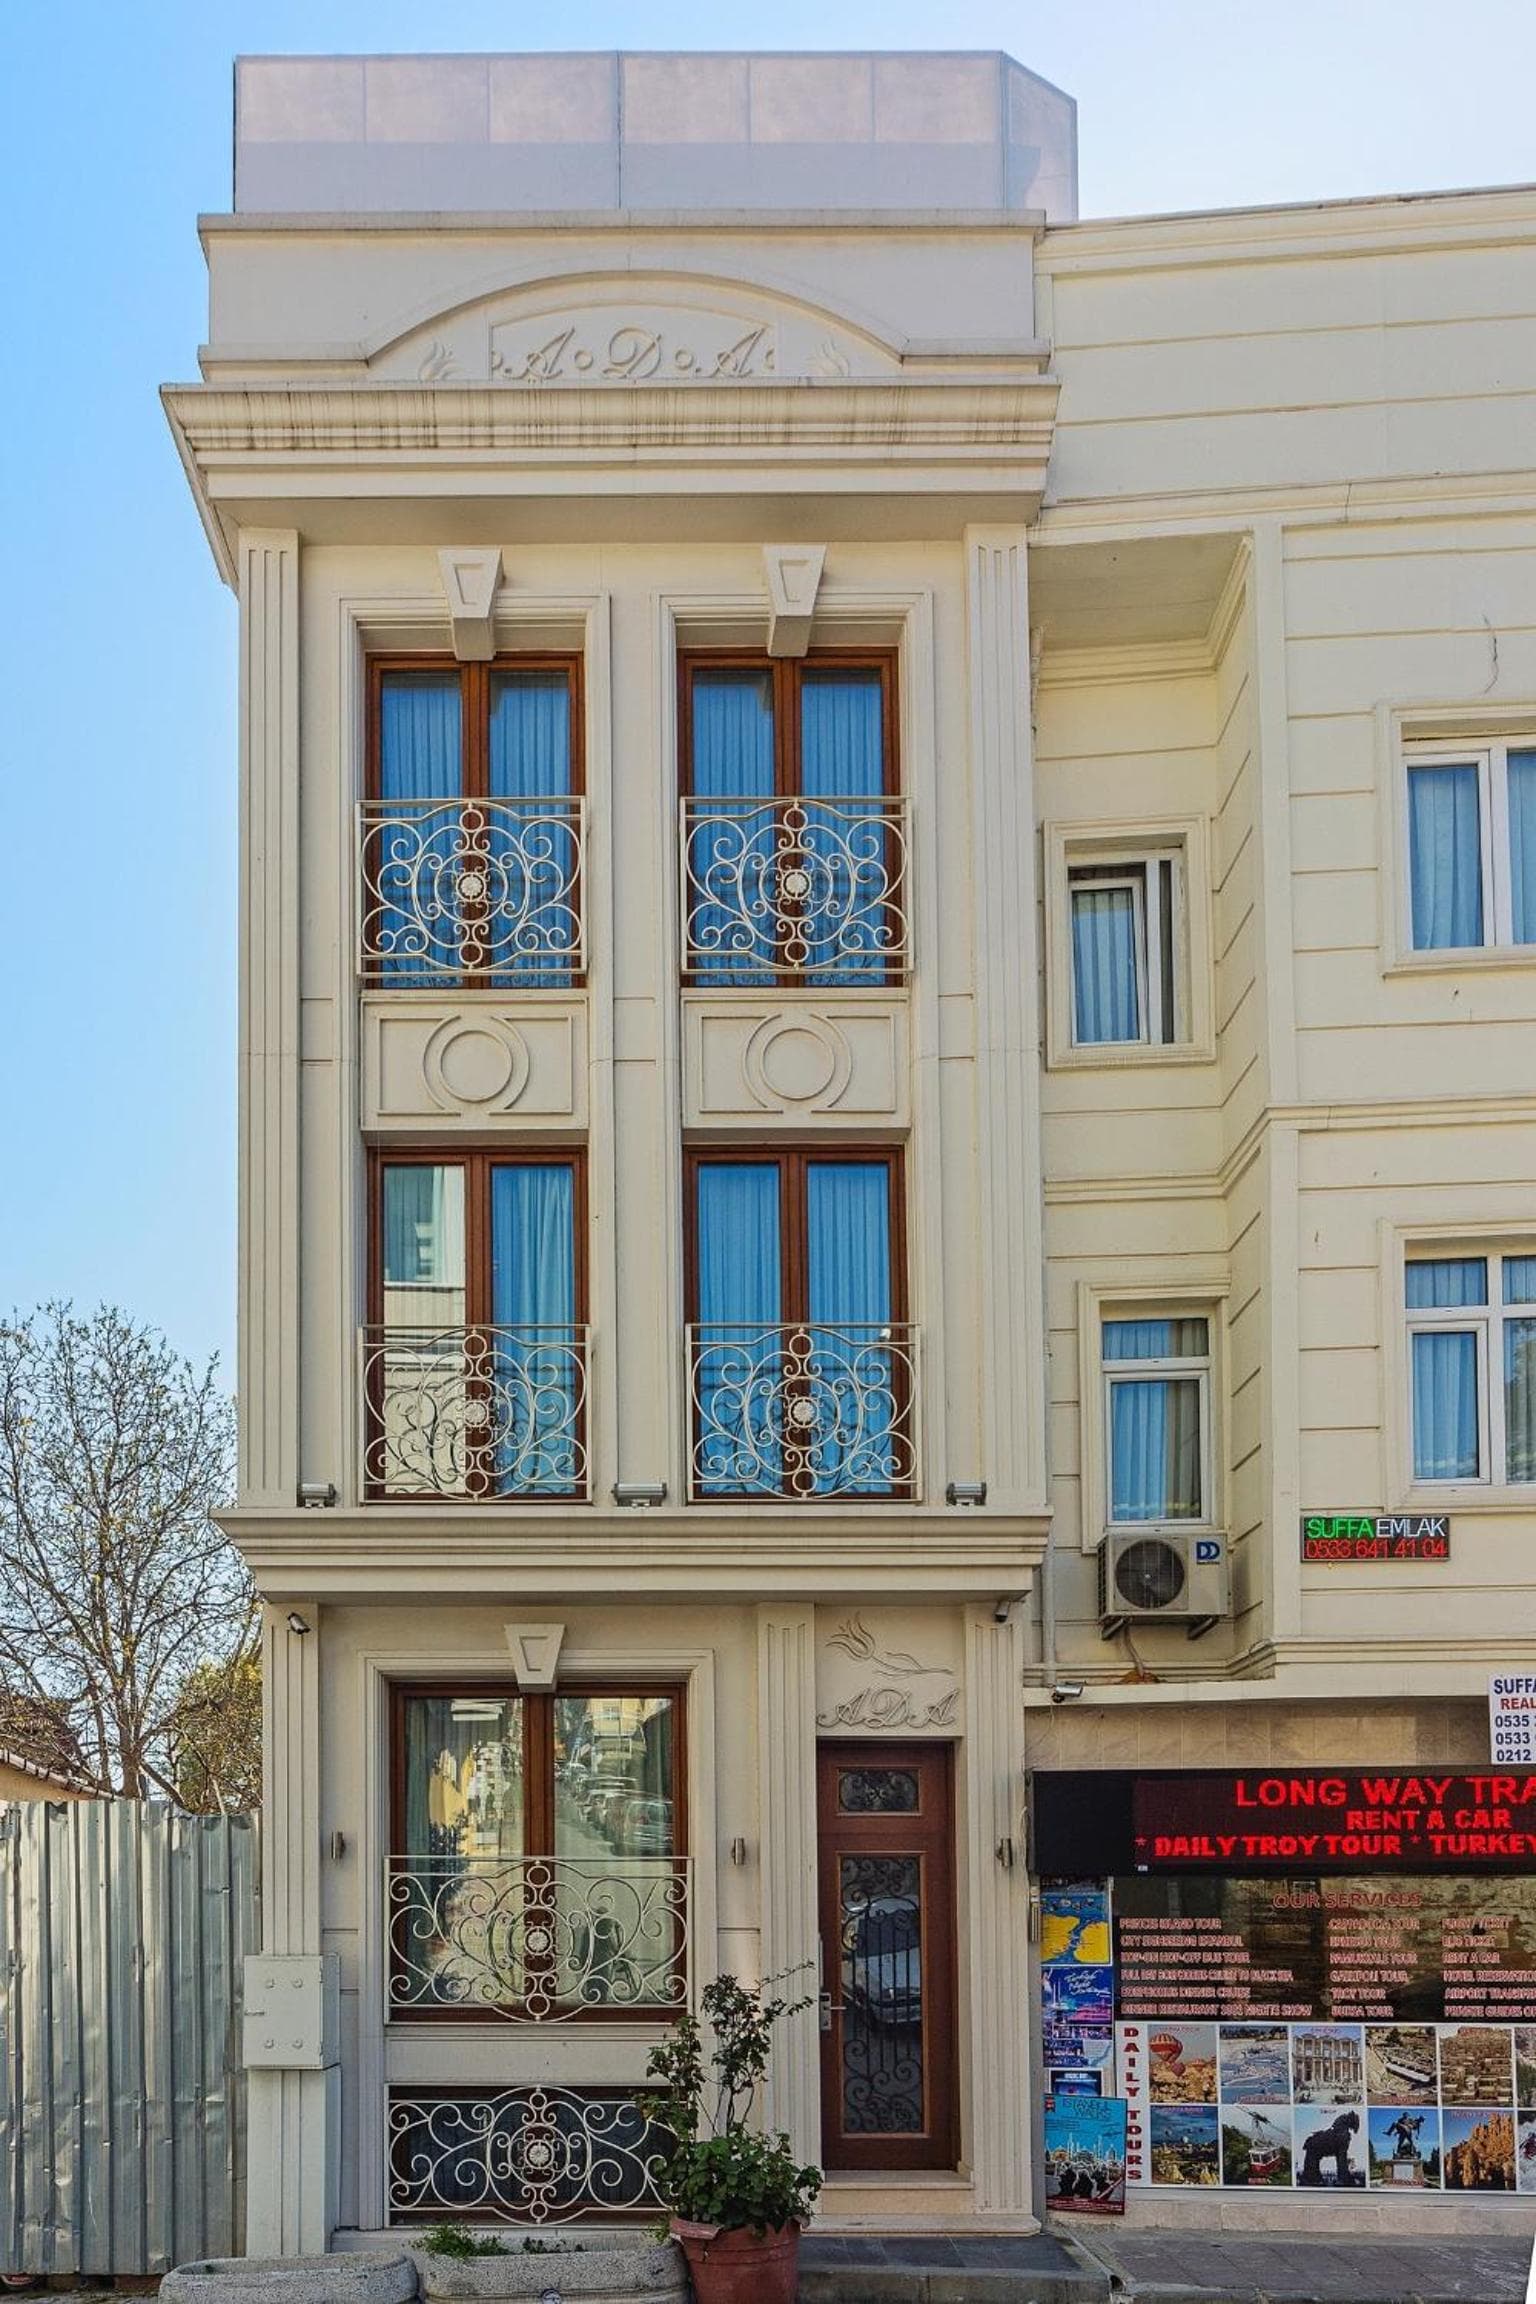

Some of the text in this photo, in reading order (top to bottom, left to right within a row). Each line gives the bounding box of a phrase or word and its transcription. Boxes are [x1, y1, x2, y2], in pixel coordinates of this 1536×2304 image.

[1308, 1518, 1446, 1538] SUFFA EMLAK
[1494, 1678, 1536, 1694] SUFF
[1495, 1715, 1530, 1727] 0535
[1496, 1732, 1531, 1745] 0533
[1497, 1749, 1532, 1761] 0212
[1235, 1778, 1347, 1807] LONG
[1361, 1777, 1453, 1805] WAY
[1346, 1808, 1512, 1830] RENT A CAR
[1154, 1836, 1237, 1856] DAILY
[1240, 1835, 1321, 1856] TROY
[1322, 1834, 1402, 1855] TOUR
[1273, 1891, 1423, 1908] OUR SERVICES
[1123, 2027, 1142, 2180] DAILY TOURS
